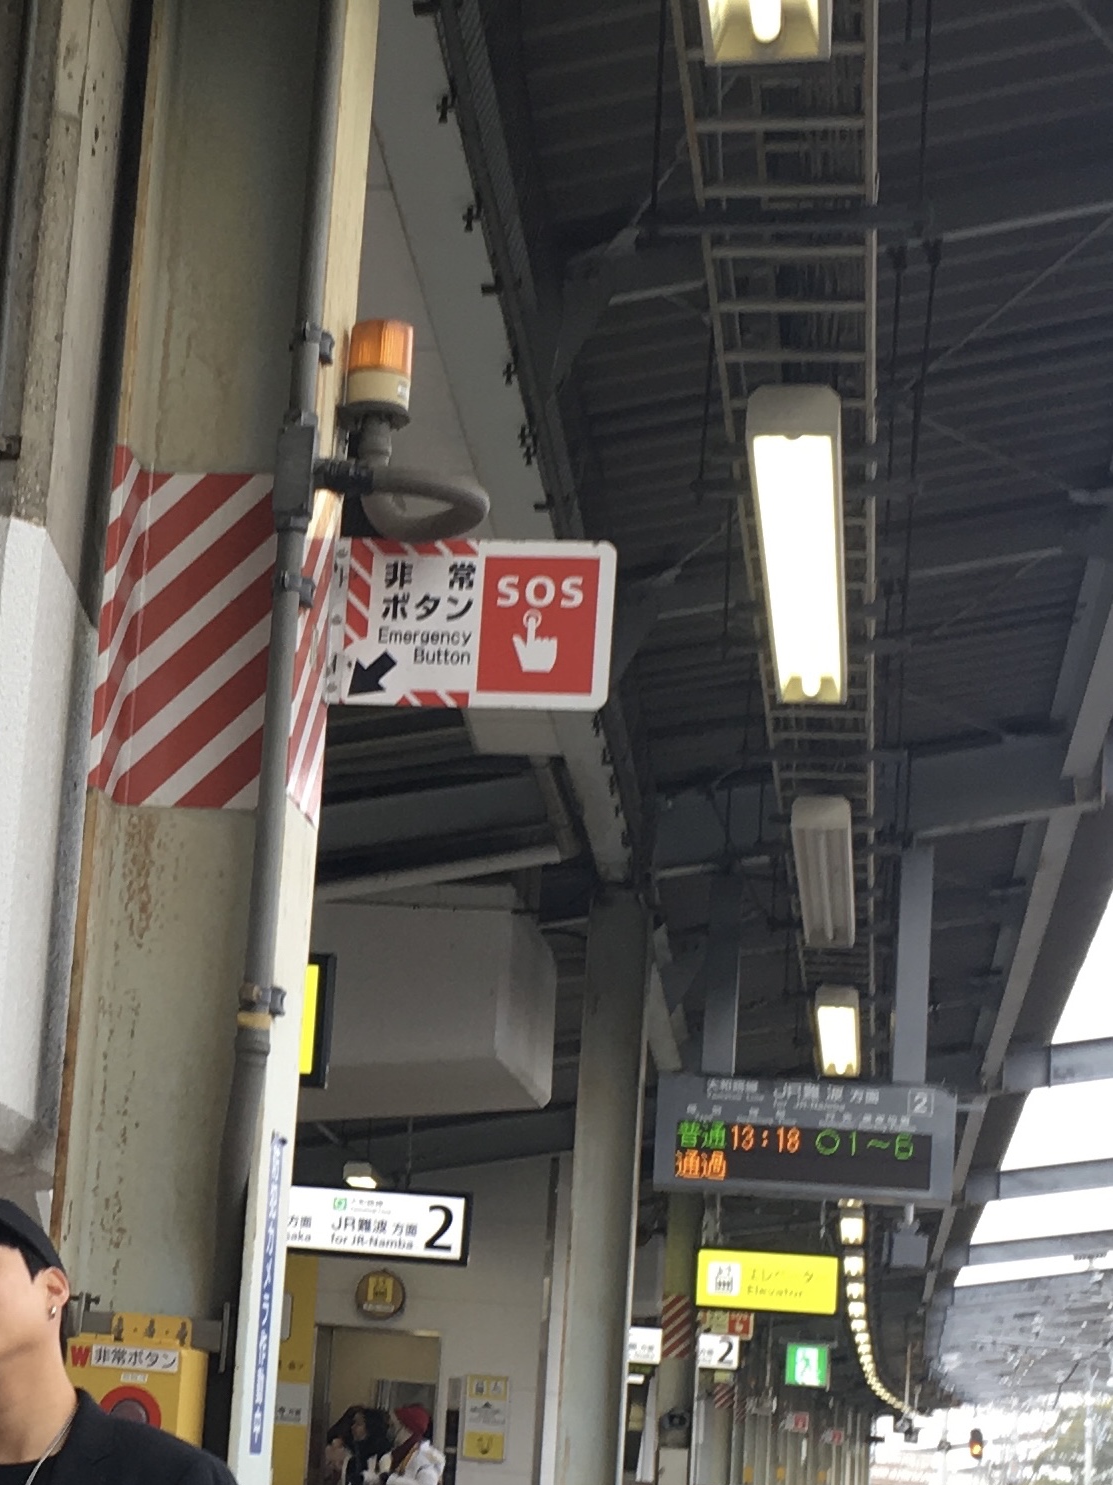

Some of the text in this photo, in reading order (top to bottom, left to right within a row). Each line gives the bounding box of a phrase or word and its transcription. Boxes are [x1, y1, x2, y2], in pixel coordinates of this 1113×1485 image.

[496, 575, 584, 609] SOS
[381, 593, 474, 622] ボタン
[378, 626, 473, 648] Emergency
[413, 648, 471, 666] Button
[914, 1092, 927, 1114] 2
[677, 1120, 726, 1149] 普通
[731, 1124, 801, 1153] 13:18
[392, 1222, 418, 1237] 方面
[424, 1204, 454, 1252] 2
[330, 1233, 414, 1249] for JR-Namba
[94, 1346, 176, 1369] 非常ボタン
[717, 1336, 734, 1364] 2
